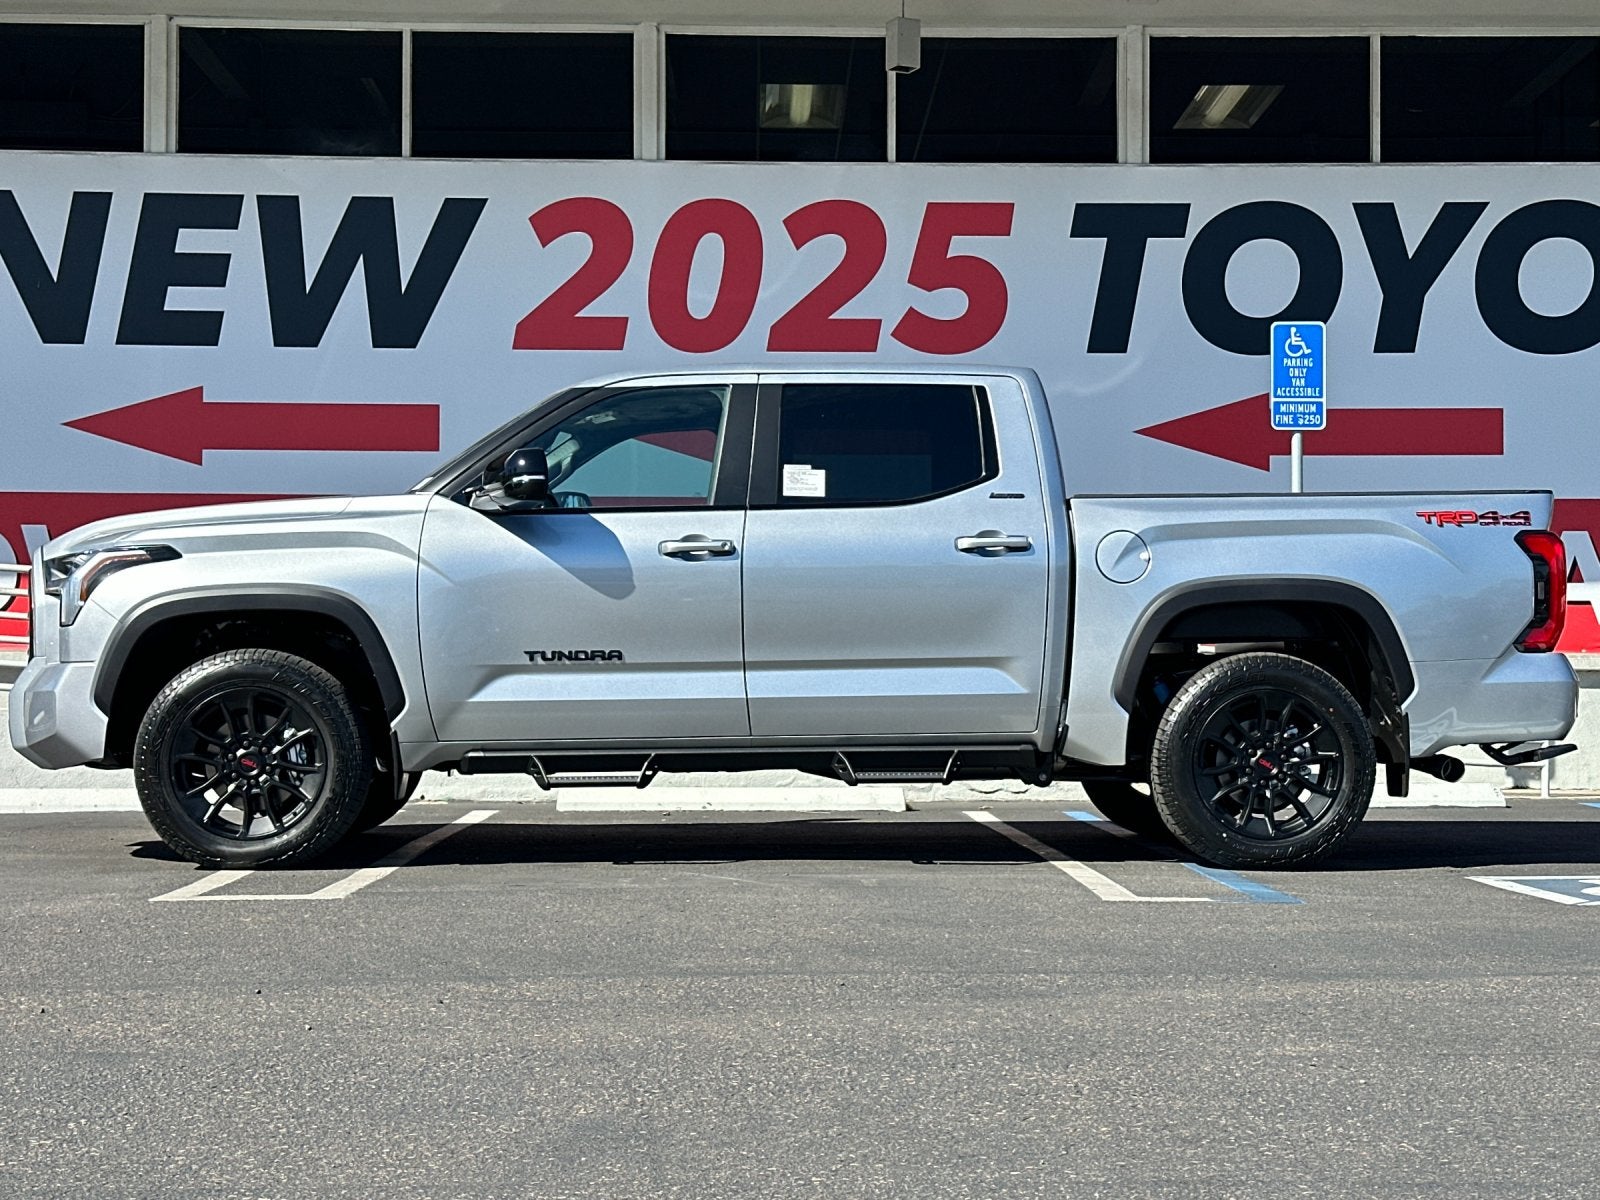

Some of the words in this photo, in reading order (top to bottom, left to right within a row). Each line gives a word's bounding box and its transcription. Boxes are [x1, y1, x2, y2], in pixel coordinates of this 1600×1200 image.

[0, 190, 489, 349] NEW
[512, 196, 1015, 355] 2025
[1069, 199, 1600, 355] TOYO
[1283, 358, 1314, 367] PARKING
[1289, 368, 1308, 377] ONLY
[1291, 378, 1306, 387] VAN
[1276, 387, 1320, 397] ACCESSIBLE
[1280, 403, 1317, 413] MINIMUM
[1275, 415, 1294, 424] FINE
[1416, 510, 1478, 527] TRD
[523, 650, 623, 662] TUNDRA
